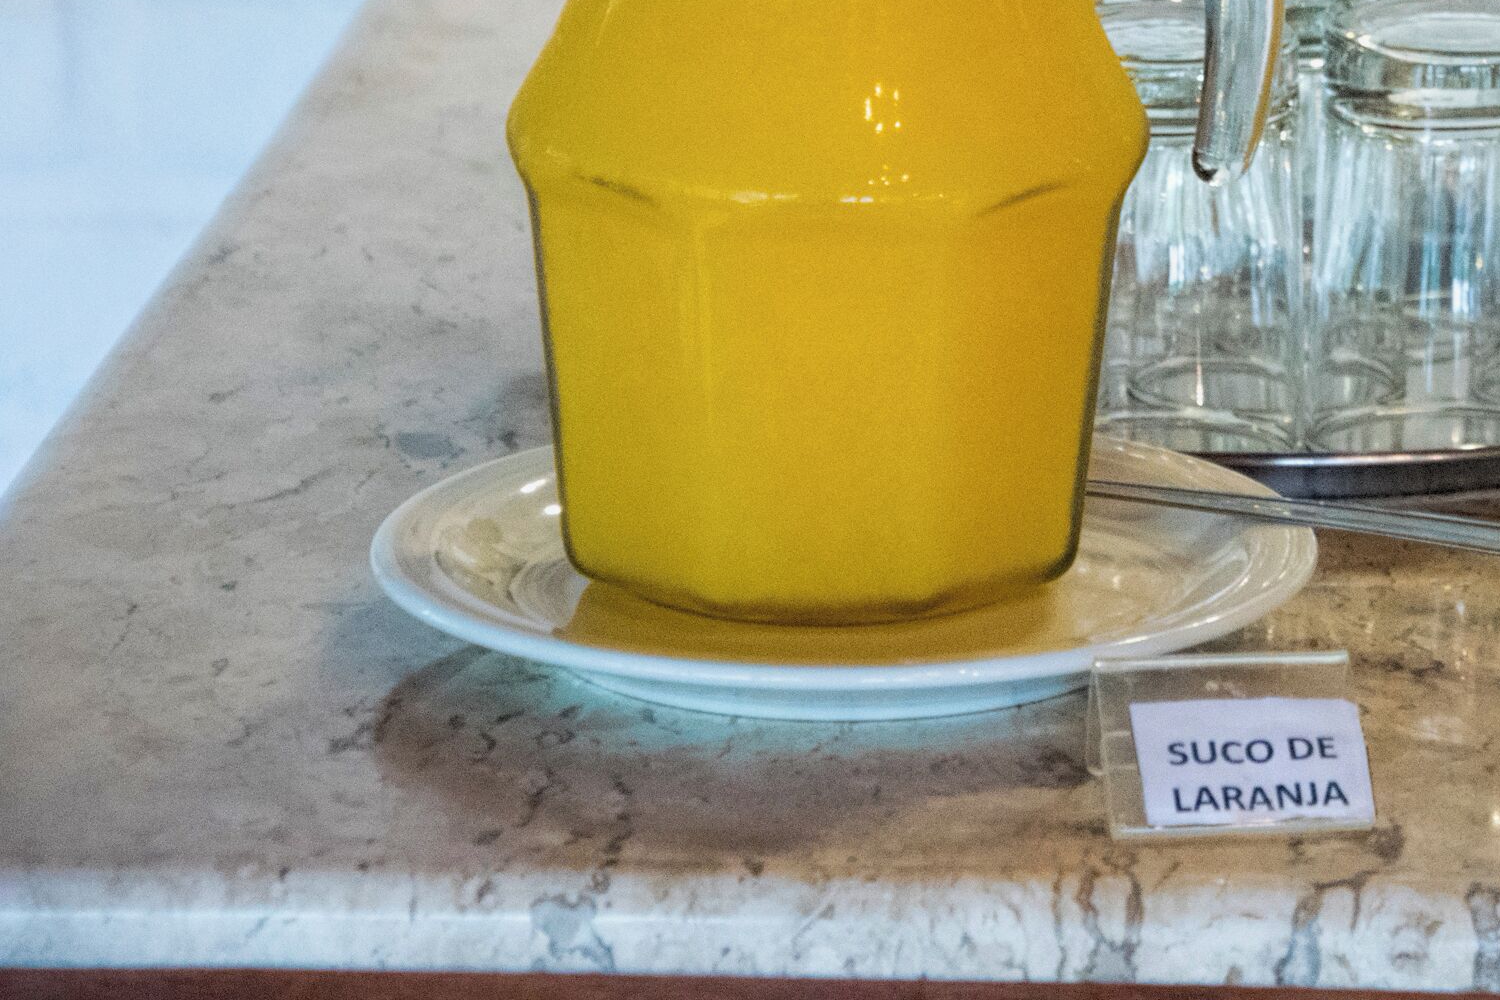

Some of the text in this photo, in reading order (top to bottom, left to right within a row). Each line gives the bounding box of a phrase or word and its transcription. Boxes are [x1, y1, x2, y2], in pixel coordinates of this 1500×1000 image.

[1167, 736, 1338, 766] SUCO DE
[1172, 780, 1350, 813] LARANJA
